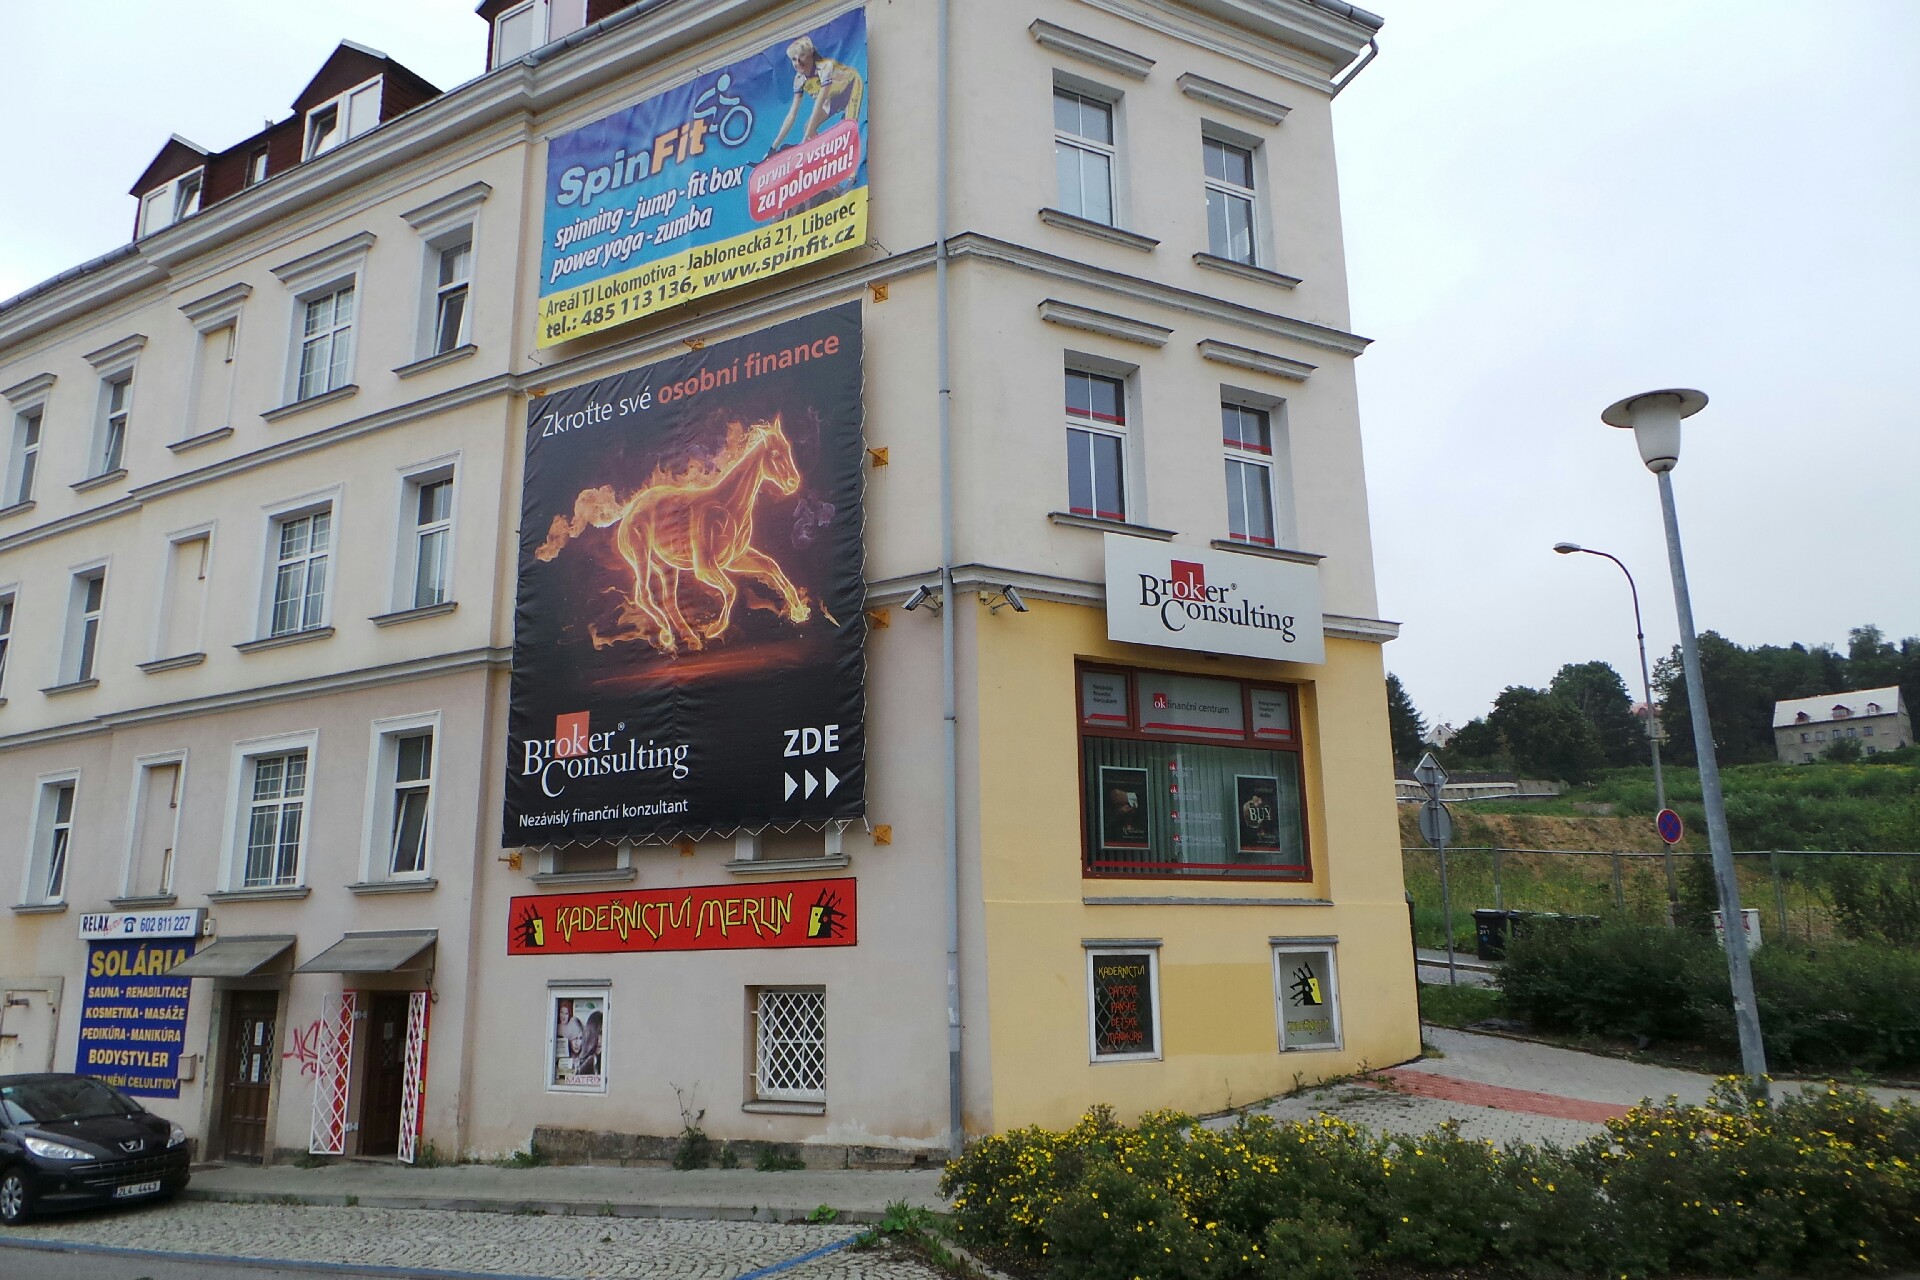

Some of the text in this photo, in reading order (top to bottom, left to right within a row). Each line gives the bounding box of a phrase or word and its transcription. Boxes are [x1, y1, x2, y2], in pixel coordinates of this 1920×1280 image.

[557, 119, 706, 205] SpinFit
[757, 131, 850, 192] první 2 vstupy
[757, 144, 853, 213] za polovinu!
[554, 165, 744, 250] spinning jump fit box
[653, 206, 713, 245] zumba
[546, 294, 579, 318] Areál
[597, 265, 676, 303] Lokomotiva
[687, 231, 771, 271] Jablonecká
[775, 224, 798, 244] 21,
[802, 201, 856, 236] Liberec
[546, 225, 855, 339] tel.: 485 113 136, www.spinfit.cz
[542, 335, 839, 437] Zkroťte své osobní finance
[1160, 600, 1296, 643] Consulting
[783, 724, 841, 758] ZDE
[540, 740, 690, 797] Consulting
[519, 800, 689, 829] Nezávislý finanční konzultant
[83, 915, 109, 932] RELAX
[140, 918, 155, 932] 602
[158, 917, 171, 931] 811
[173, 916, 190, 931] 227
[696, 892, 793, 938] MERLIN
[90, 944, 186, 976] SOLÁRIA
[85, 1005, 185, 1019] KOSMETIKA MASÁŽE
[88, 986, 188, 998] SAUNA REHABILITACE
[82, 1025, 181, 1042] PEDIKÚRA MANIKÚRA
[88, 1049, 168, 1067] BODYSTYLER
[128, 1077, 178, 1089] CELULITIDY
